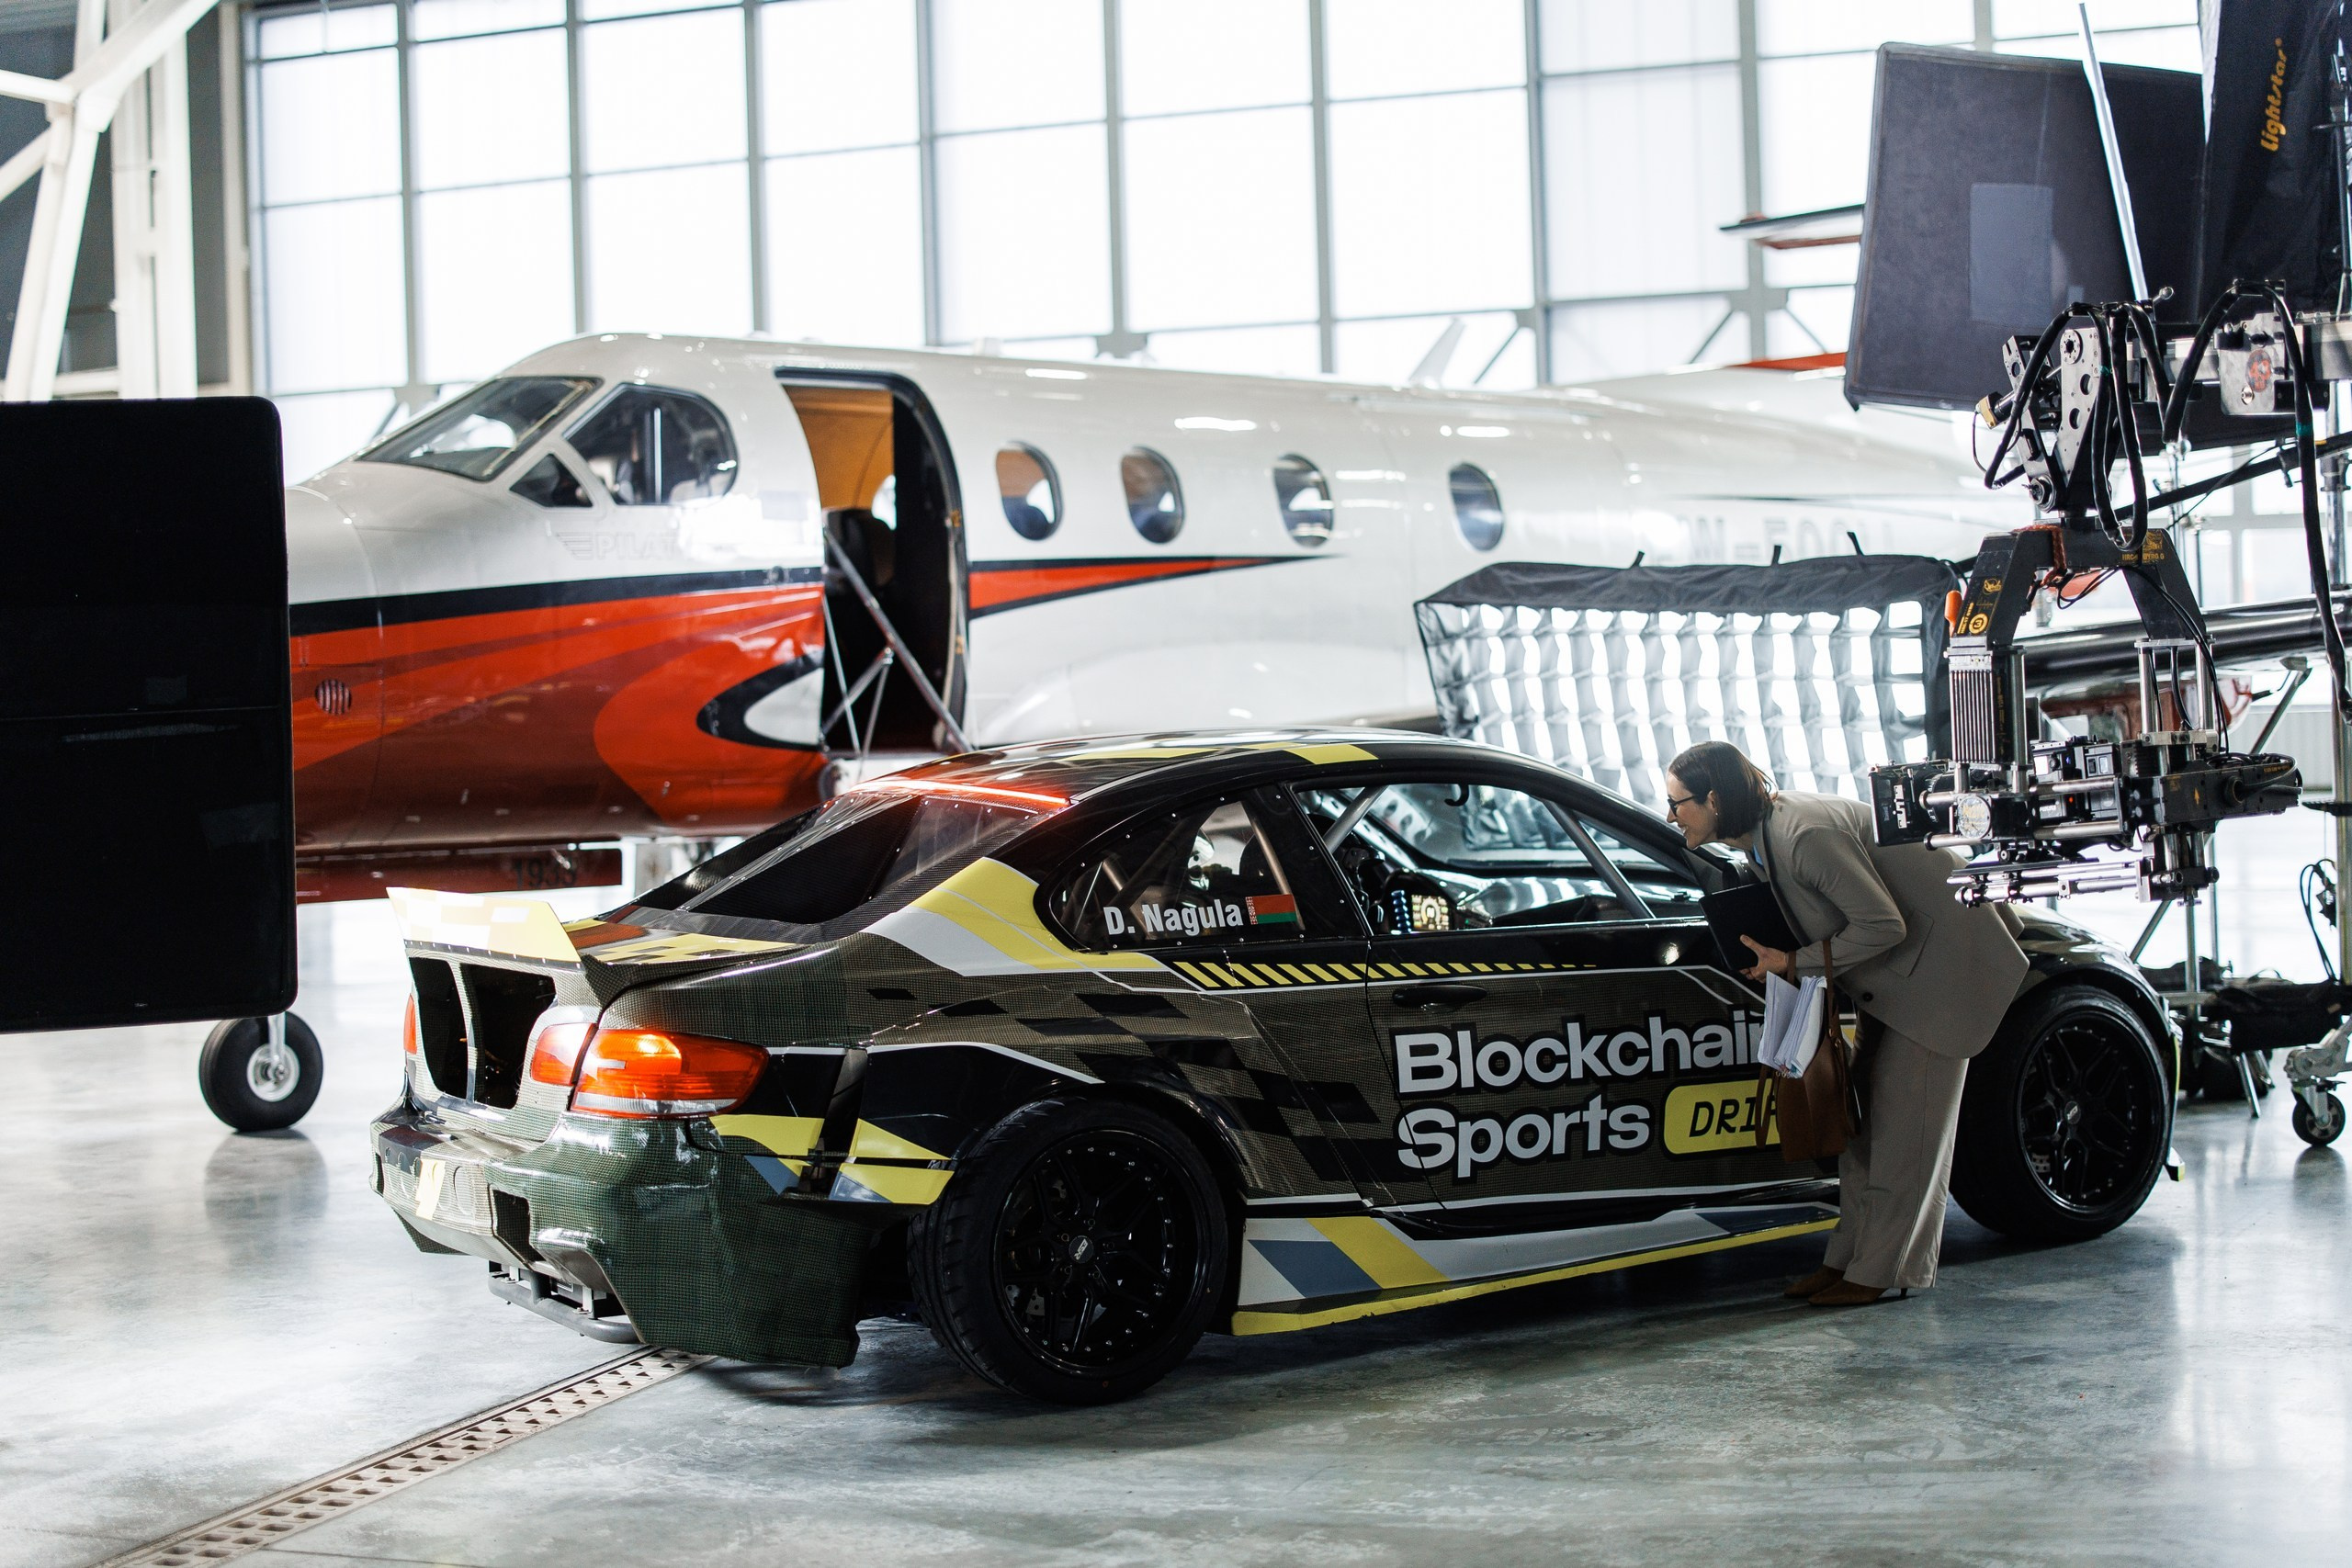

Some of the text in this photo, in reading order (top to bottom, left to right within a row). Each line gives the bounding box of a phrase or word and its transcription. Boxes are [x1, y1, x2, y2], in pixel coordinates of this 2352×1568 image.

[2260, 49, 2287, 152] lightstar
[596, 531, 685, 560] PILAT
[1103, 899, 1243, 936] D. Nagula
[1398, 1095, 1650, 1178] Sports
